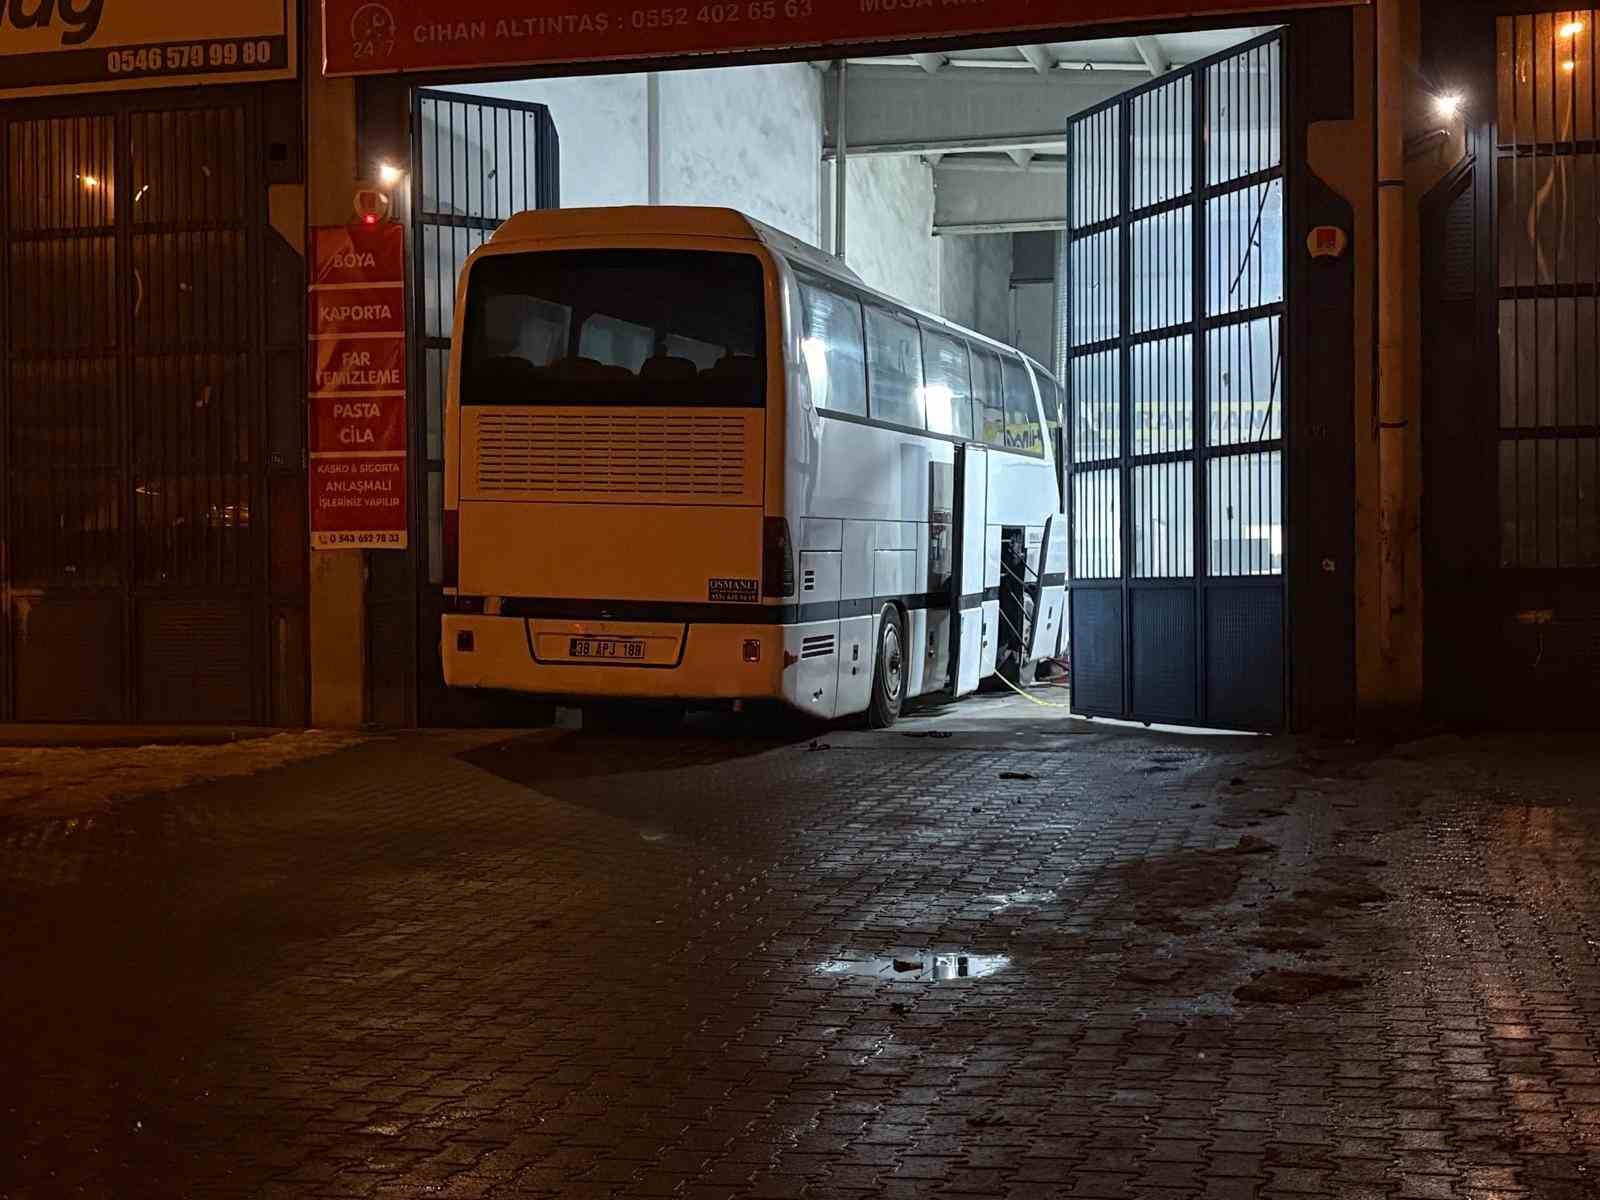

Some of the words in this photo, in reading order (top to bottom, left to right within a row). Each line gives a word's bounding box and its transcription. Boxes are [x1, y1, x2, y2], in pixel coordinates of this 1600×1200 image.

[631, 7, 689, 29] 0552
[696, 3, 741, 24] 402
[750, 0, 777, 20] 65
[784, 0, 813, 18] 63
[106, 48, 163, 73] 0546
[166, 44, 204, 69] 579
[208, 42, 239, 66] 99
[242, 40, 271, 64] 80
[333, 252, 376, 268] BOYA
[320, 304, 392, 321] KAPORTA
[342, 351, 371, 367] FAR
[334, 403, 381, 418] PASTA
[340, 425, 375, 443] CİLA
[329, 534, 337, 544] 0
